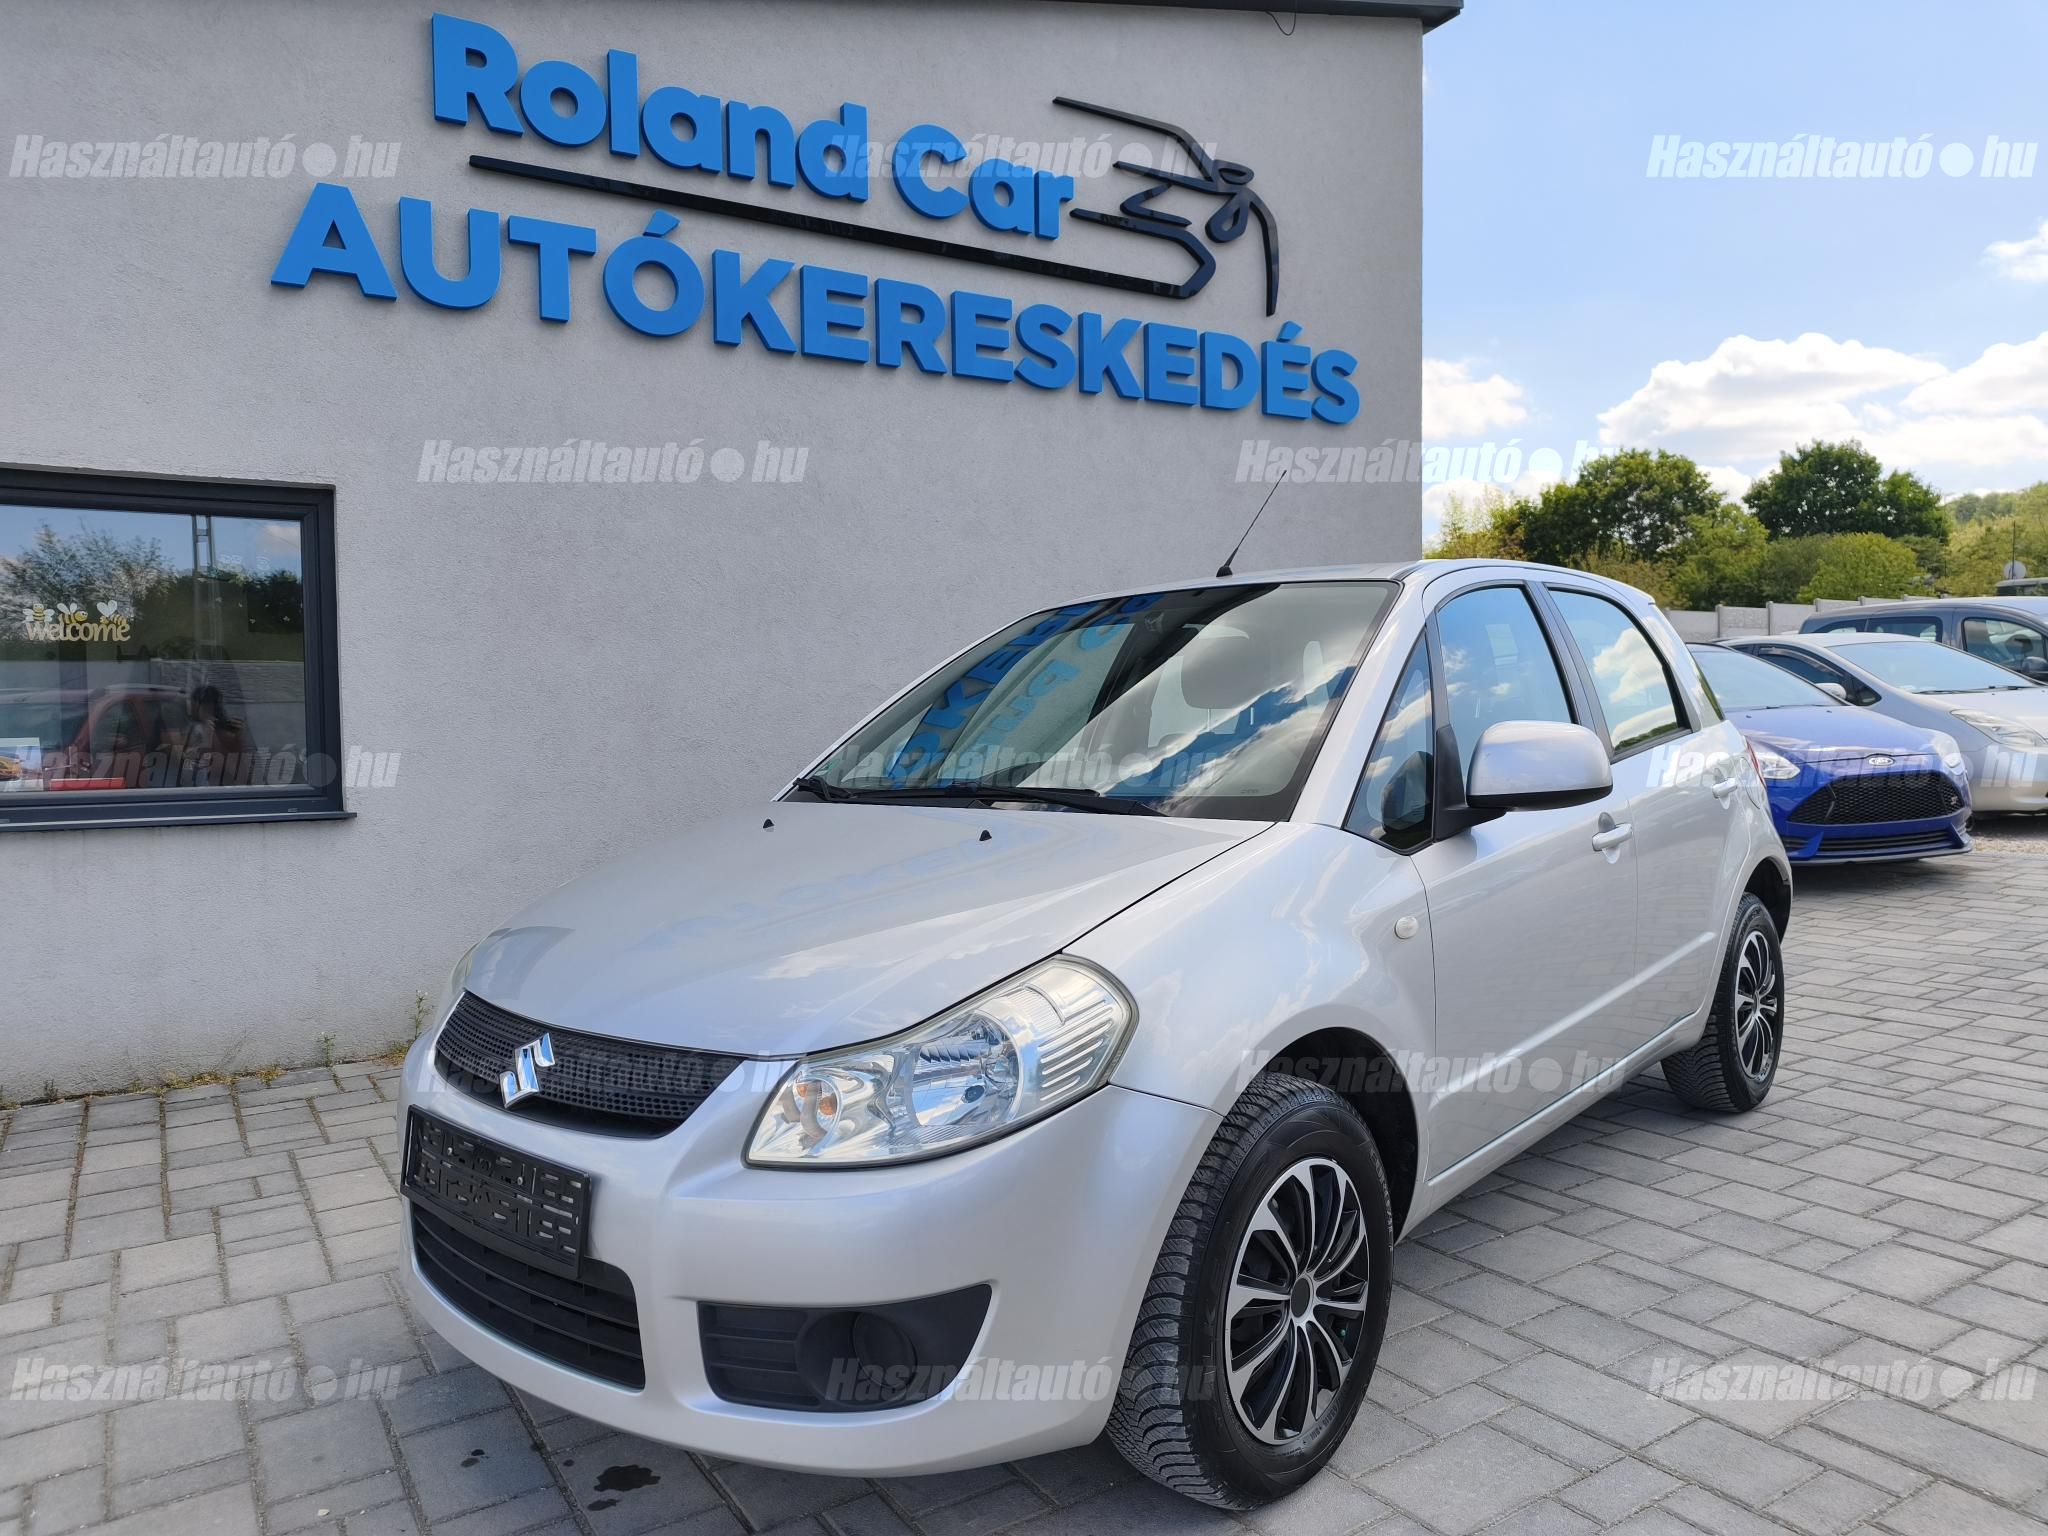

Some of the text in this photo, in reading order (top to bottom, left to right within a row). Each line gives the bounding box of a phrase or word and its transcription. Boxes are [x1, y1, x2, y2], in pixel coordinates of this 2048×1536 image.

[431, 13, 1074, 240] Roland Car
[271, 183, 1360, 425] AUTÓKERESKEDÉS
